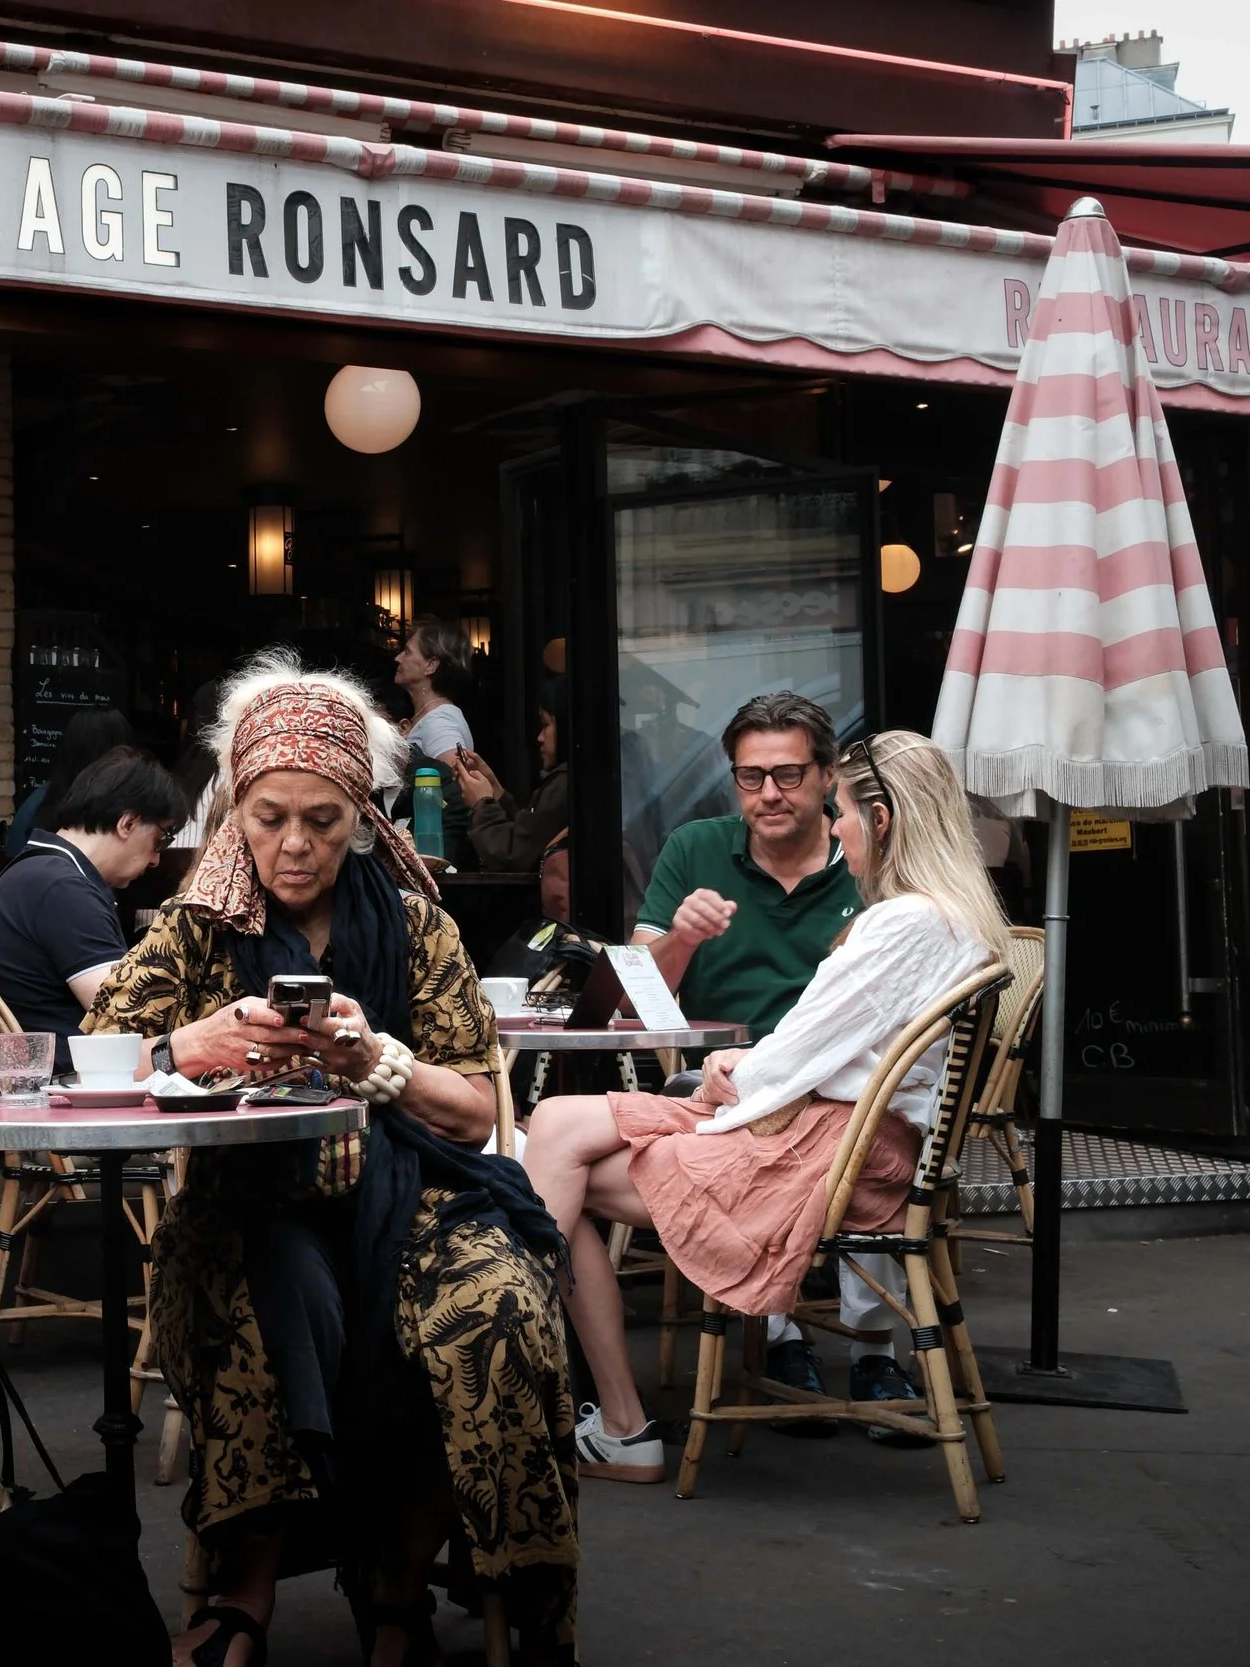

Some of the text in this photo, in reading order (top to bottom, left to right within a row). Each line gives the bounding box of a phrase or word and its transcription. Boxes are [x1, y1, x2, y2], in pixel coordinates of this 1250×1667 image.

[226, 182, 596, 311] RONSARD
[1004, 278, 1250, 375] RAURA
[35, 677, 52, 698] Les
